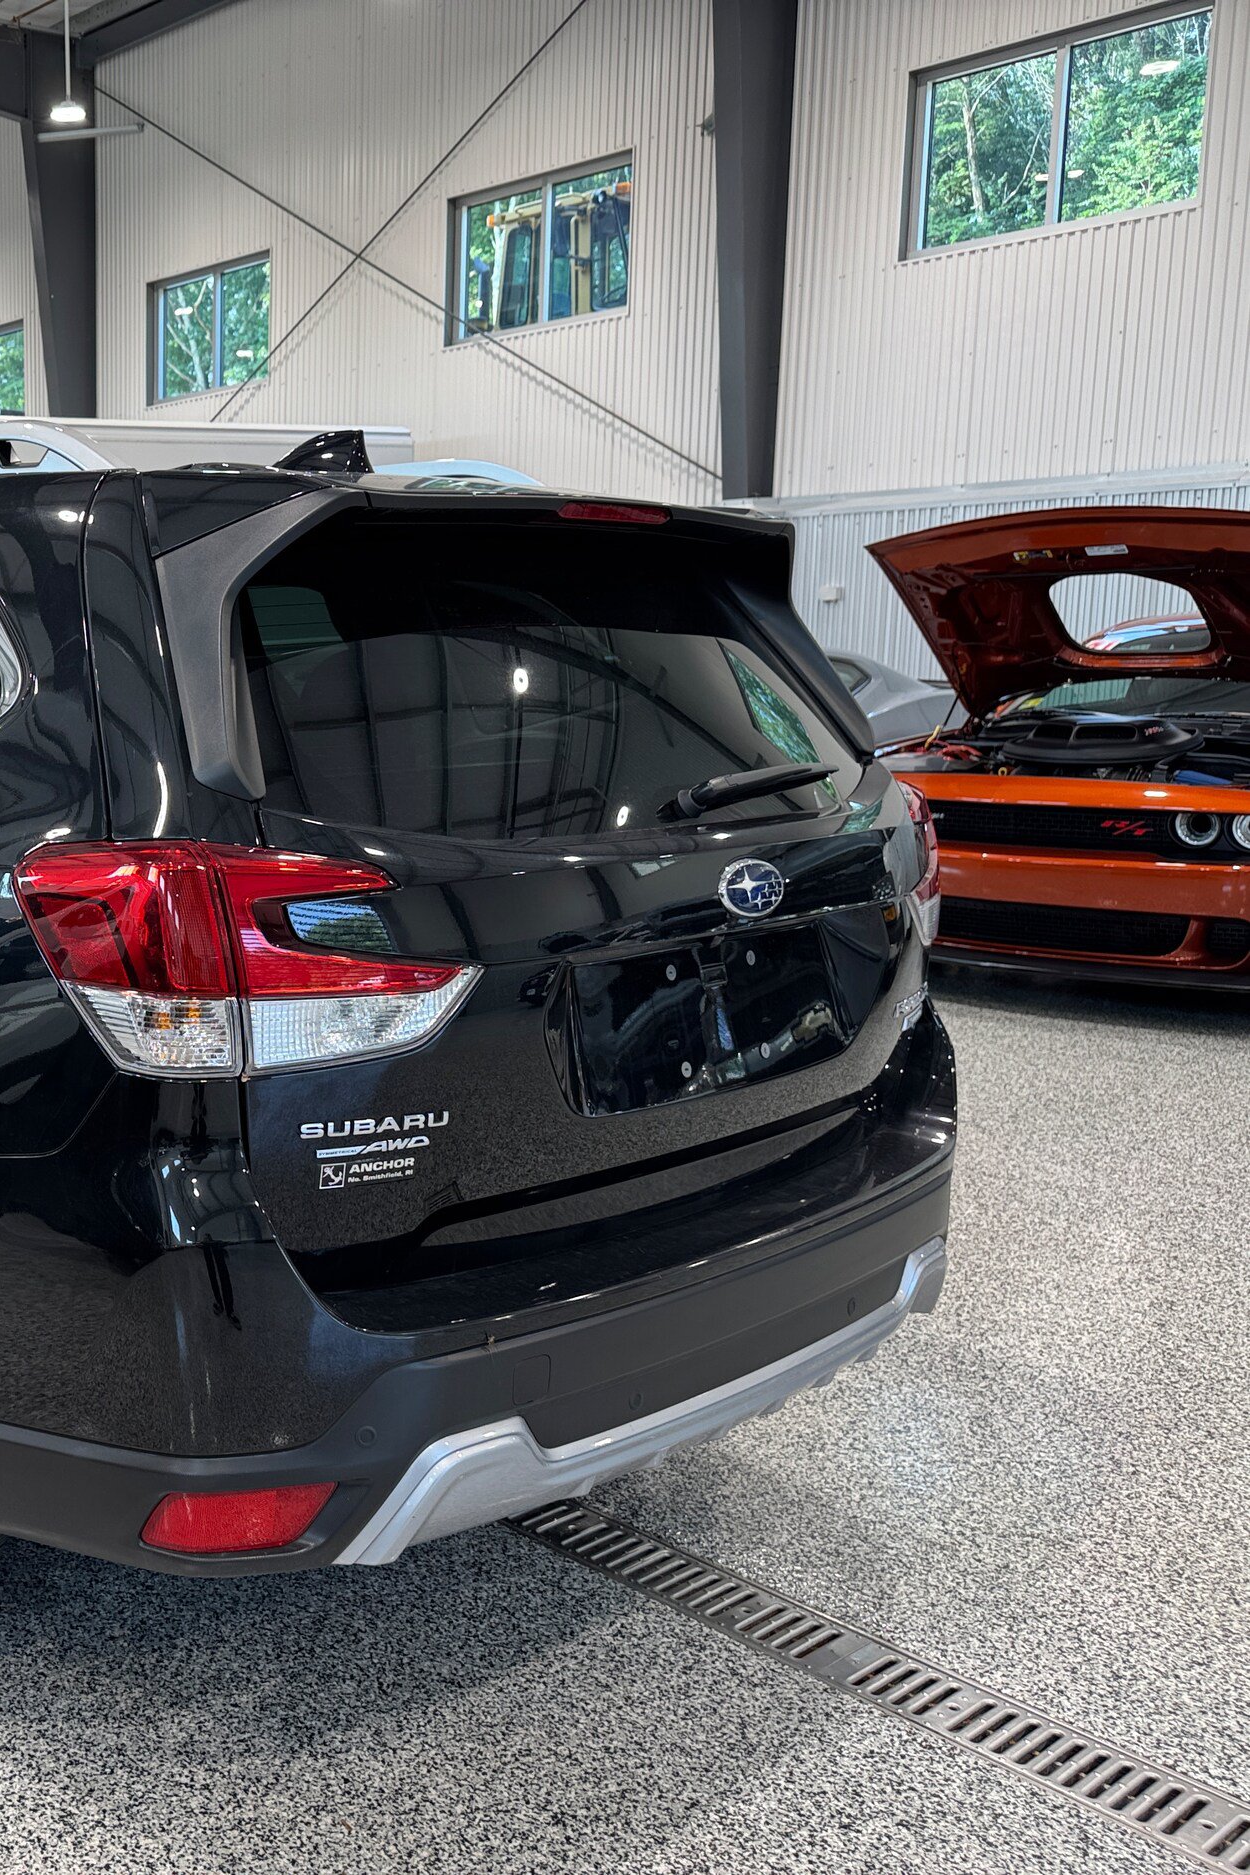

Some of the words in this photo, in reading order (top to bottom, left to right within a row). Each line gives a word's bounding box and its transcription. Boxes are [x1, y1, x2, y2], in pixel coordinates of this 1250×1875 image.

[300, 1110, 449, 1139] SUBARU
[360, 1135, 430, 1155] AWD
[349, 1157, 415, 1174] ANCHOR
